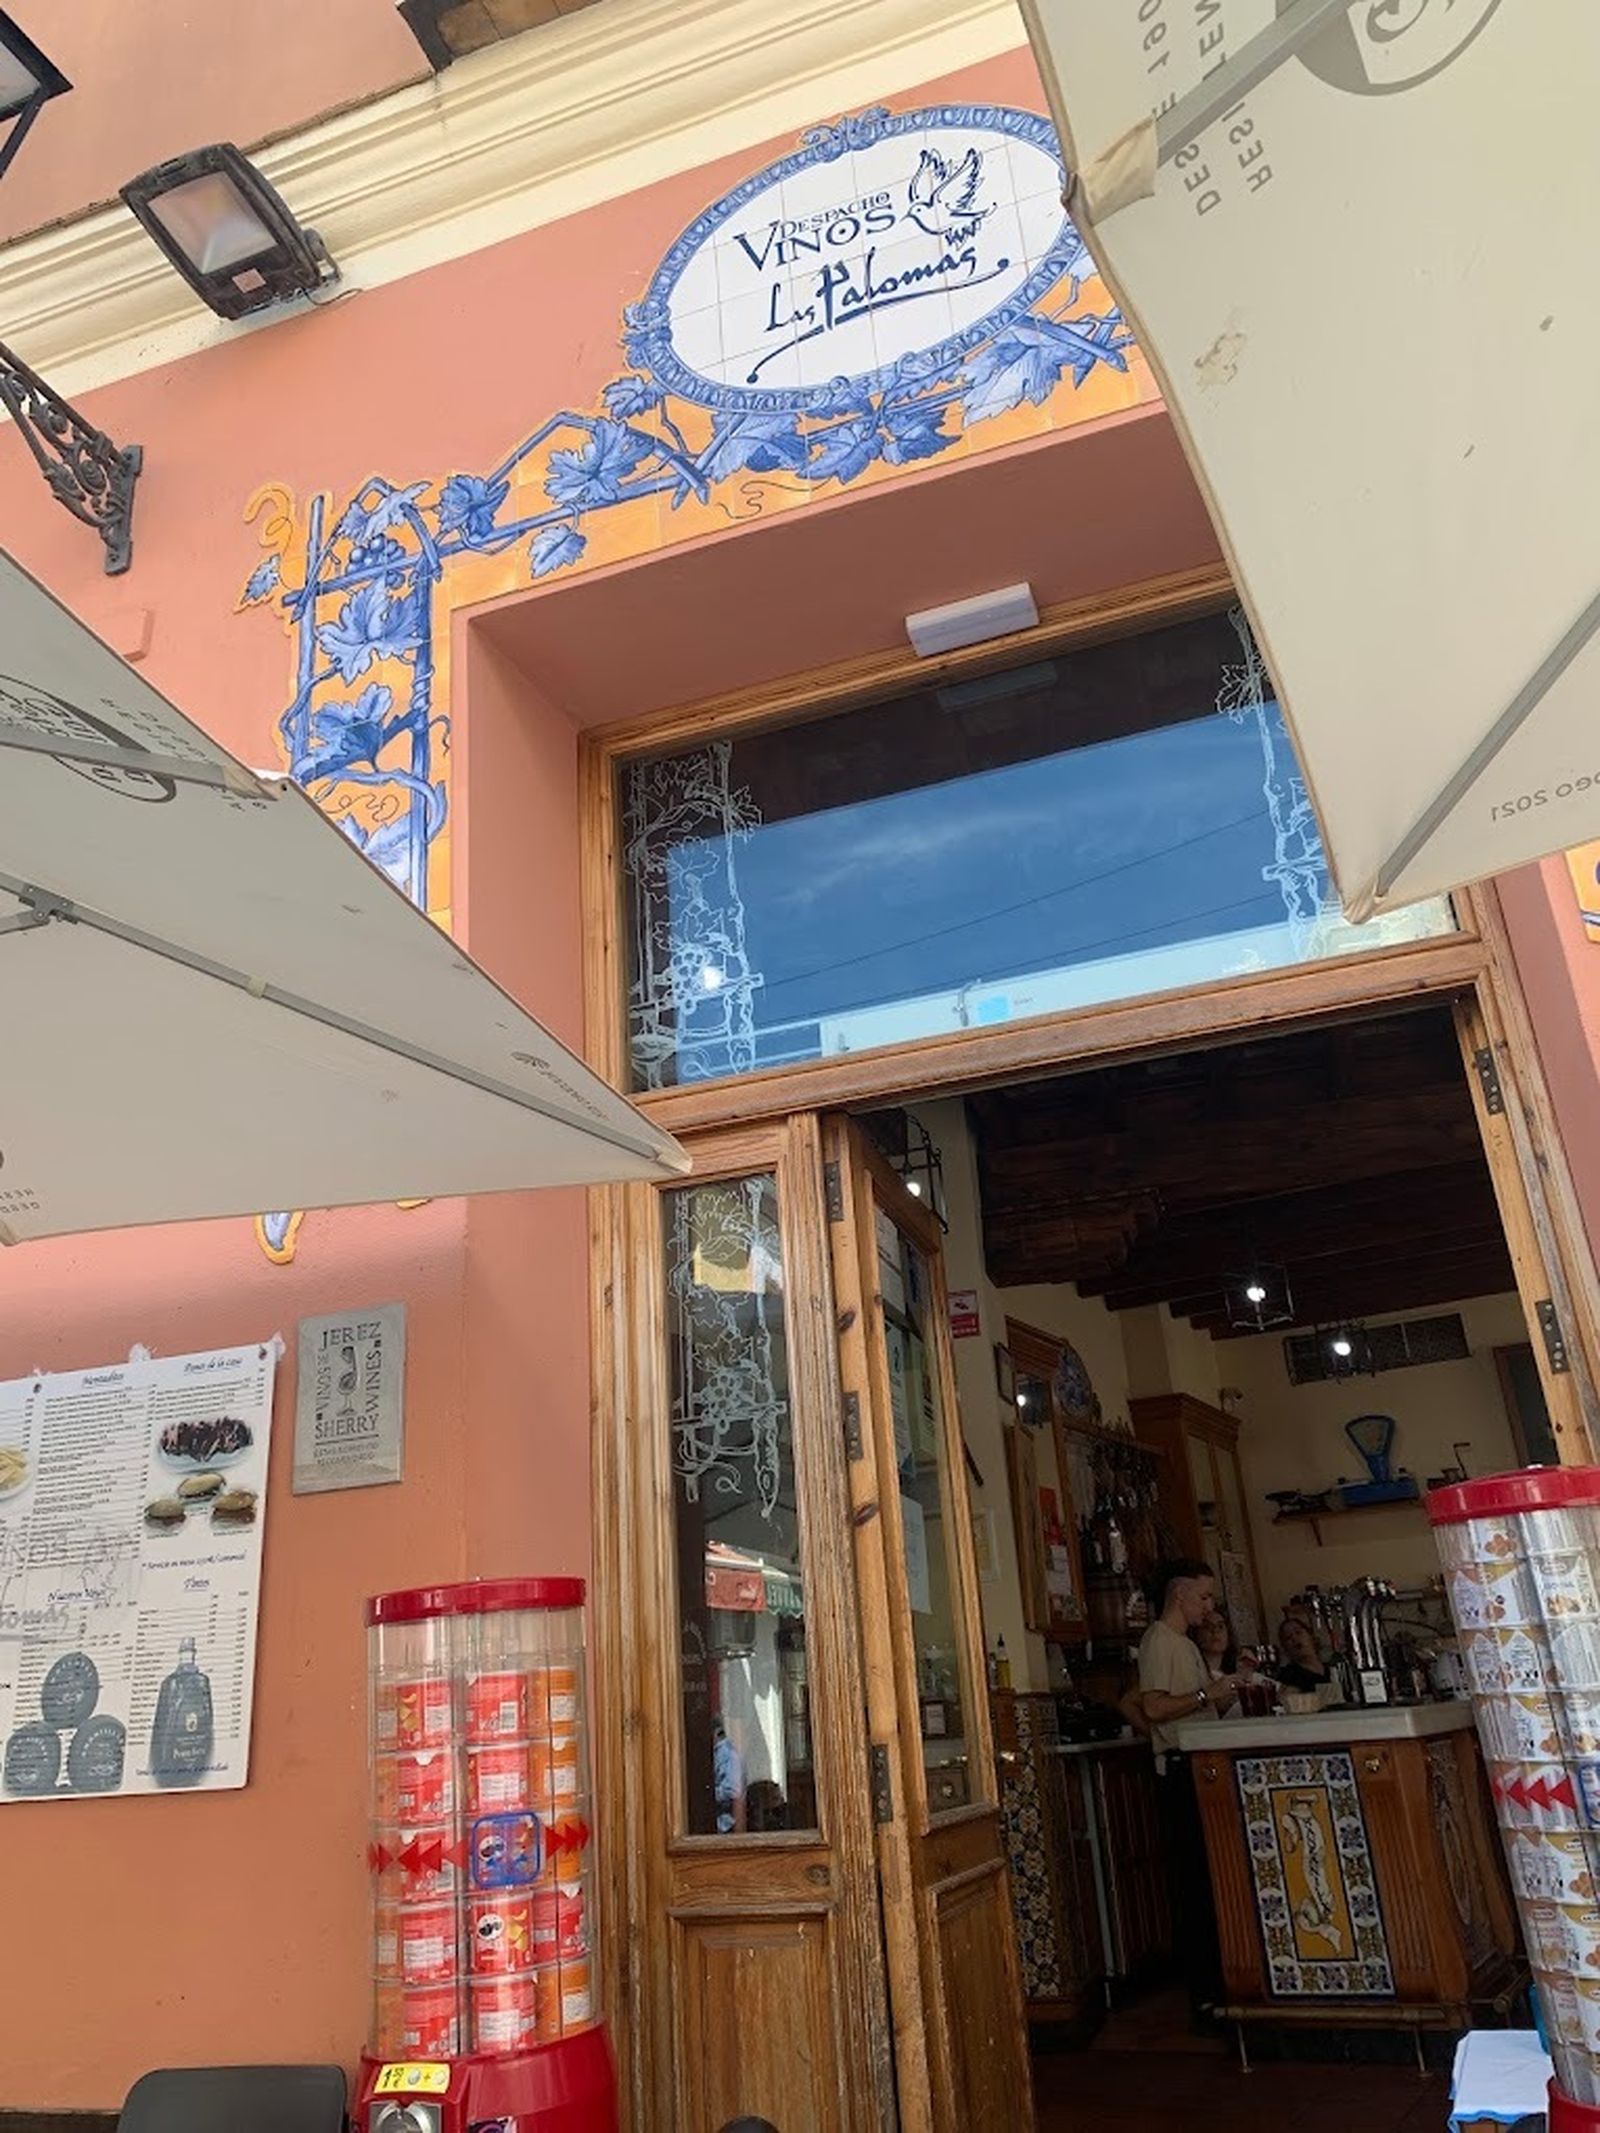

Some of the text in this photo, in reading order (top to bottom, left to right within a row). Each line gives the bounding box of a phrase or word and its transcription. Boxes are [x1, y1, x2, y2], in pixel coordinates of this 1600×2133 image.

[733, 203, 897, 273] VINOS
[780, 191, 891, 237] DESPACHO
[764, 246, 978, 334] Las Palomas
[321, 1320, 382, 1352] JEREZ
[365, 1349, 382, 1413] WINES
[314, 1412, 380, 1439] SHERRY
